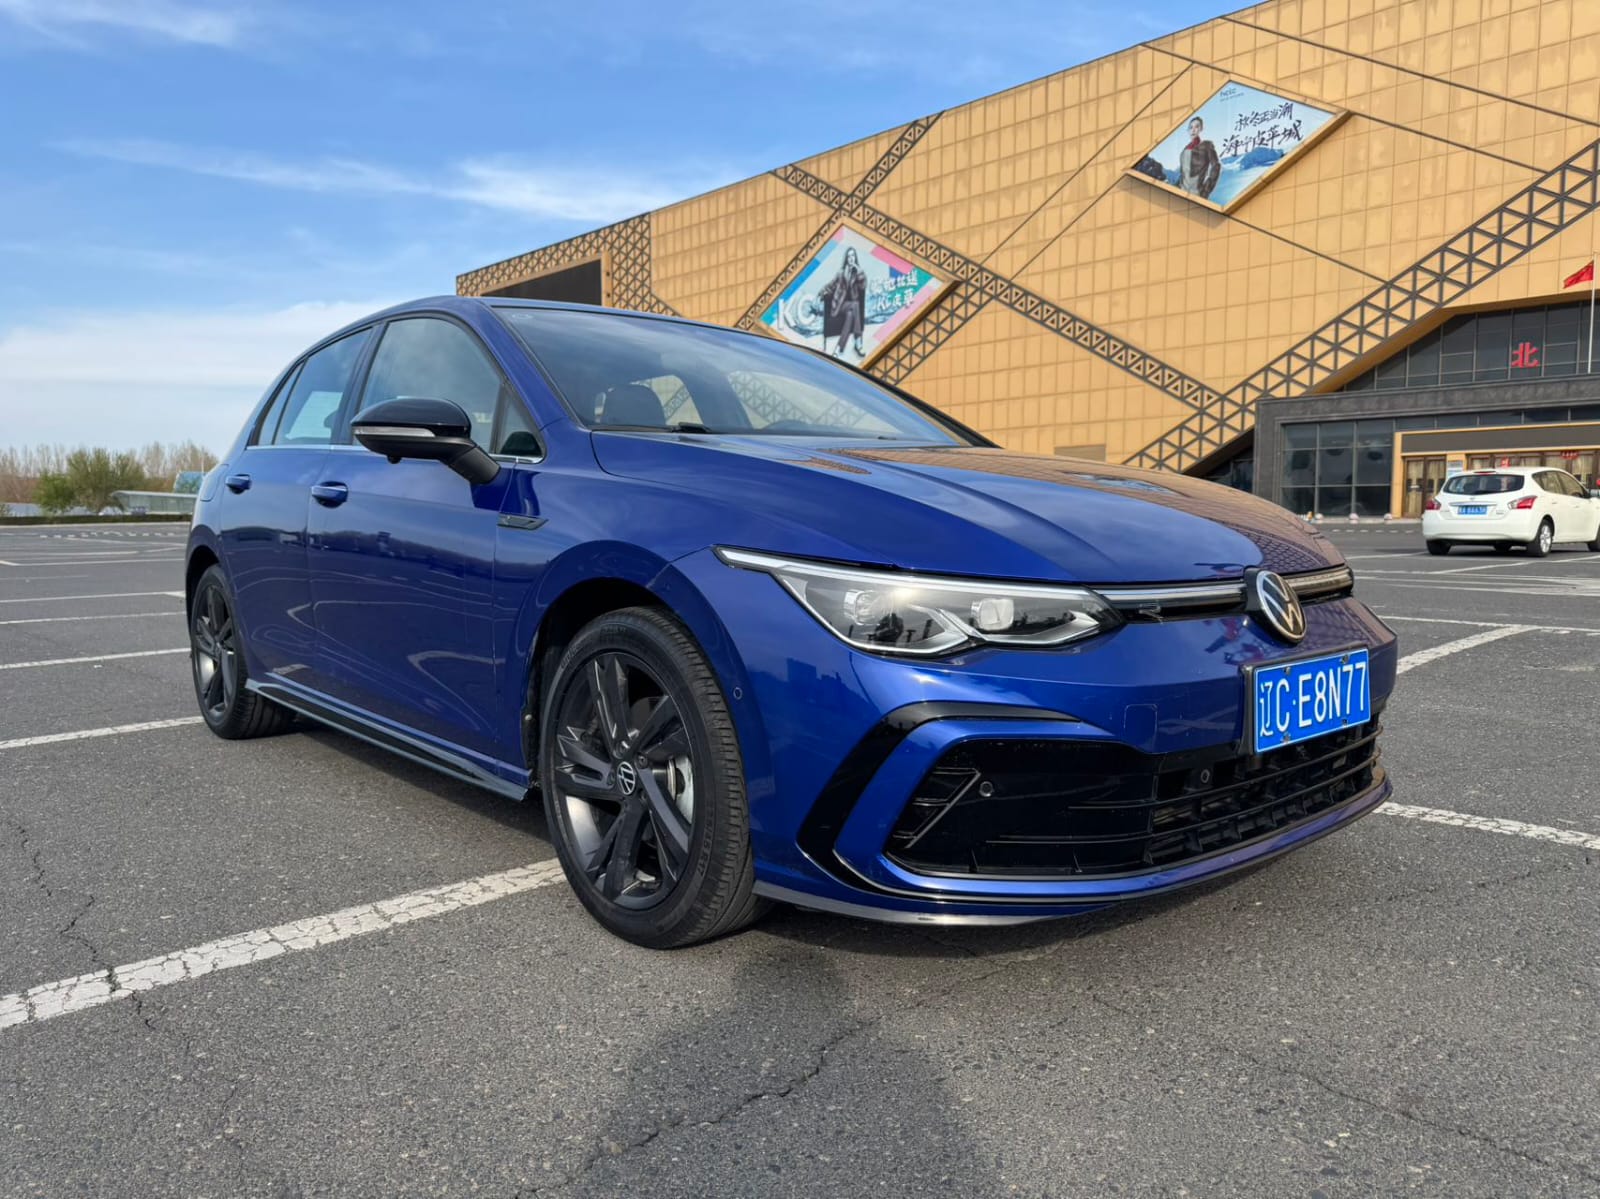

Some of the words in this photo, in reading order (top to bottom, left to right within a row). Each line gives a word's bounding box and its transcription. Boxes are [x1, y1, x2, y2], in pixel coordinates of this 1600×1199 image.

[1219, 119, 1304, 158] 海宁皮革城
[1512, 342, 1539, 368] 北
